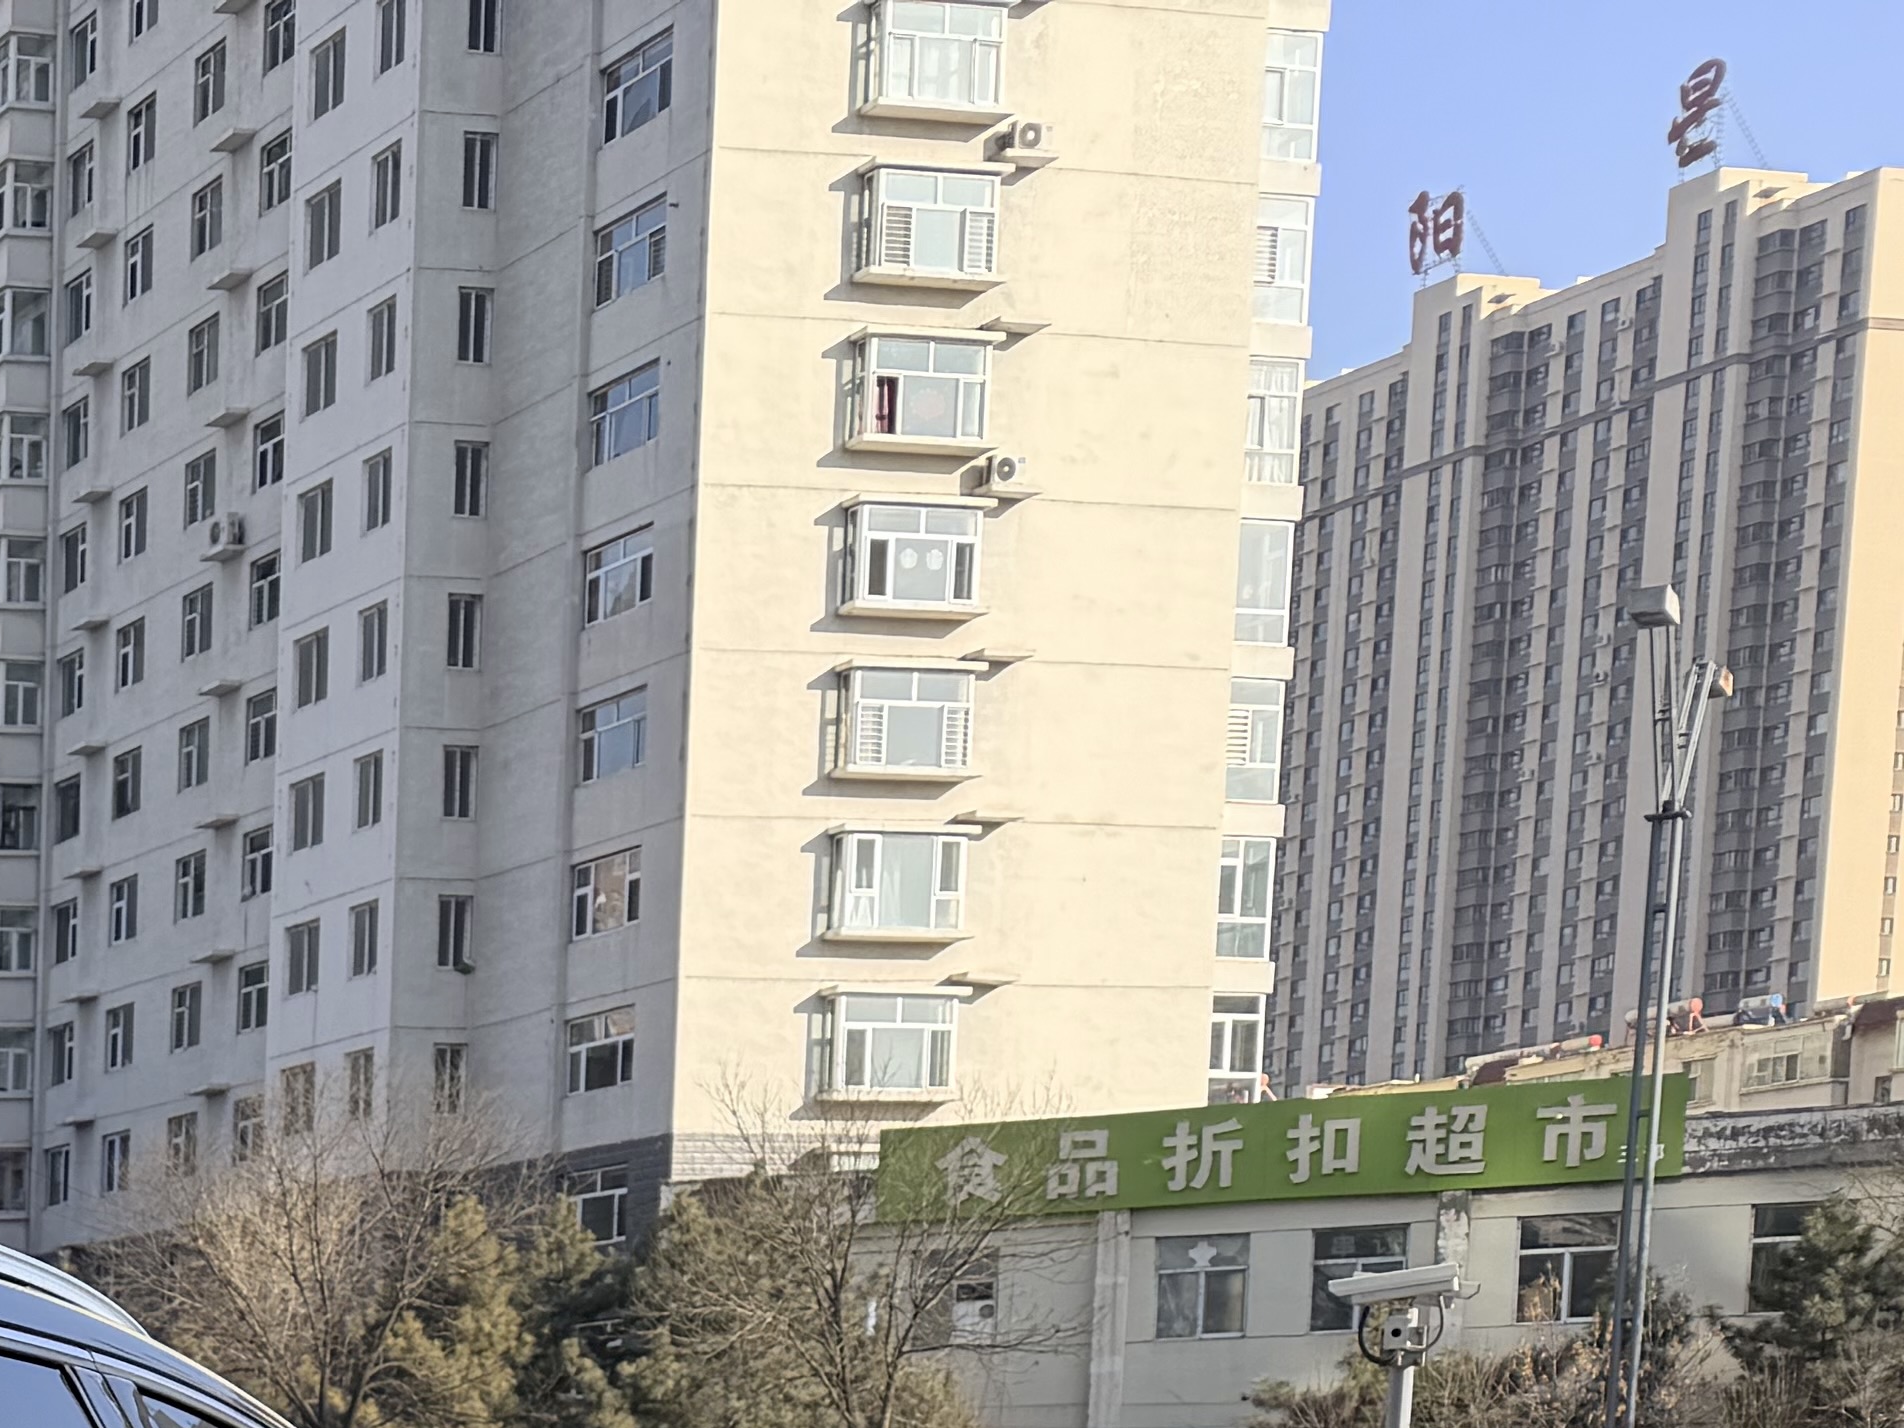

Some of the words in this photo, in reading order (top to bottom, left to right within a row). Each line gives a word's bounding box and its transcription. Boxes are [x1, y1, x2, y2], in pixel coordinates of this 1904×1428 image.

[934, 1094, 1619, 1205] 食品折扣超市
